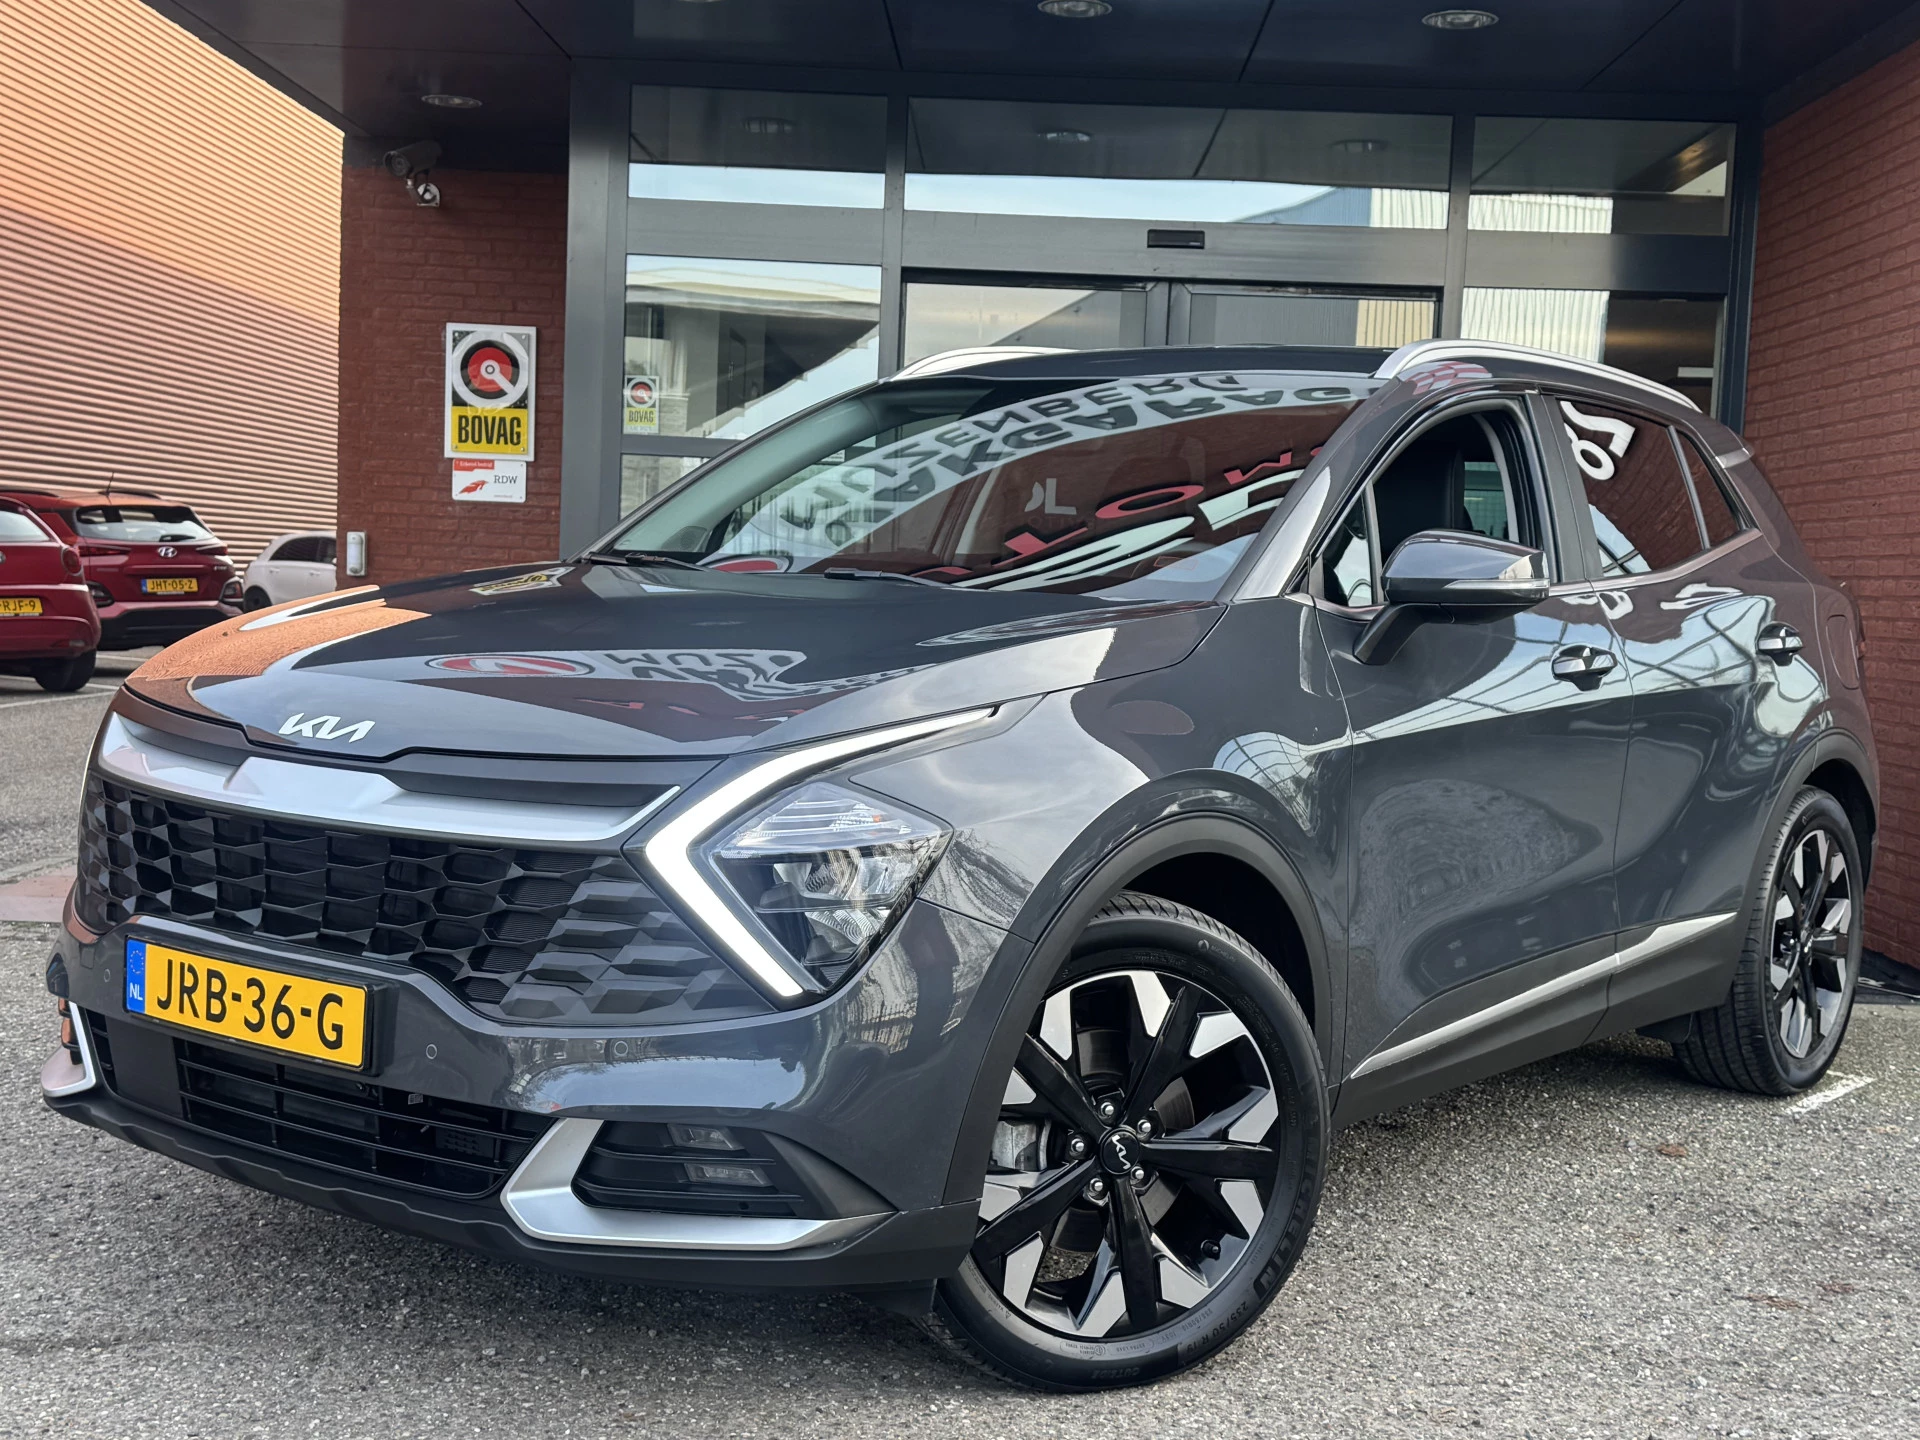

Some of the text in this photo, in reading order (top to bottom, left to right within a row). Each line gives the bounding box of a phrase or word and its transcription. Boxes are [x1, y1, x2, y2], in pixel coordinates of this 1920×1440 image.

[628, 410, 655, 423] BOVAG
[458, 414, 522, 446] BOVAG
[493, 474, 518, 485] RDW
[150, 579, 194, 591] JHT-05-Z
[278, 712, 376, 744] KIA
[129, 981, 144, 1001] NL
[156, 957, 344, 1050] JRB-36-G
